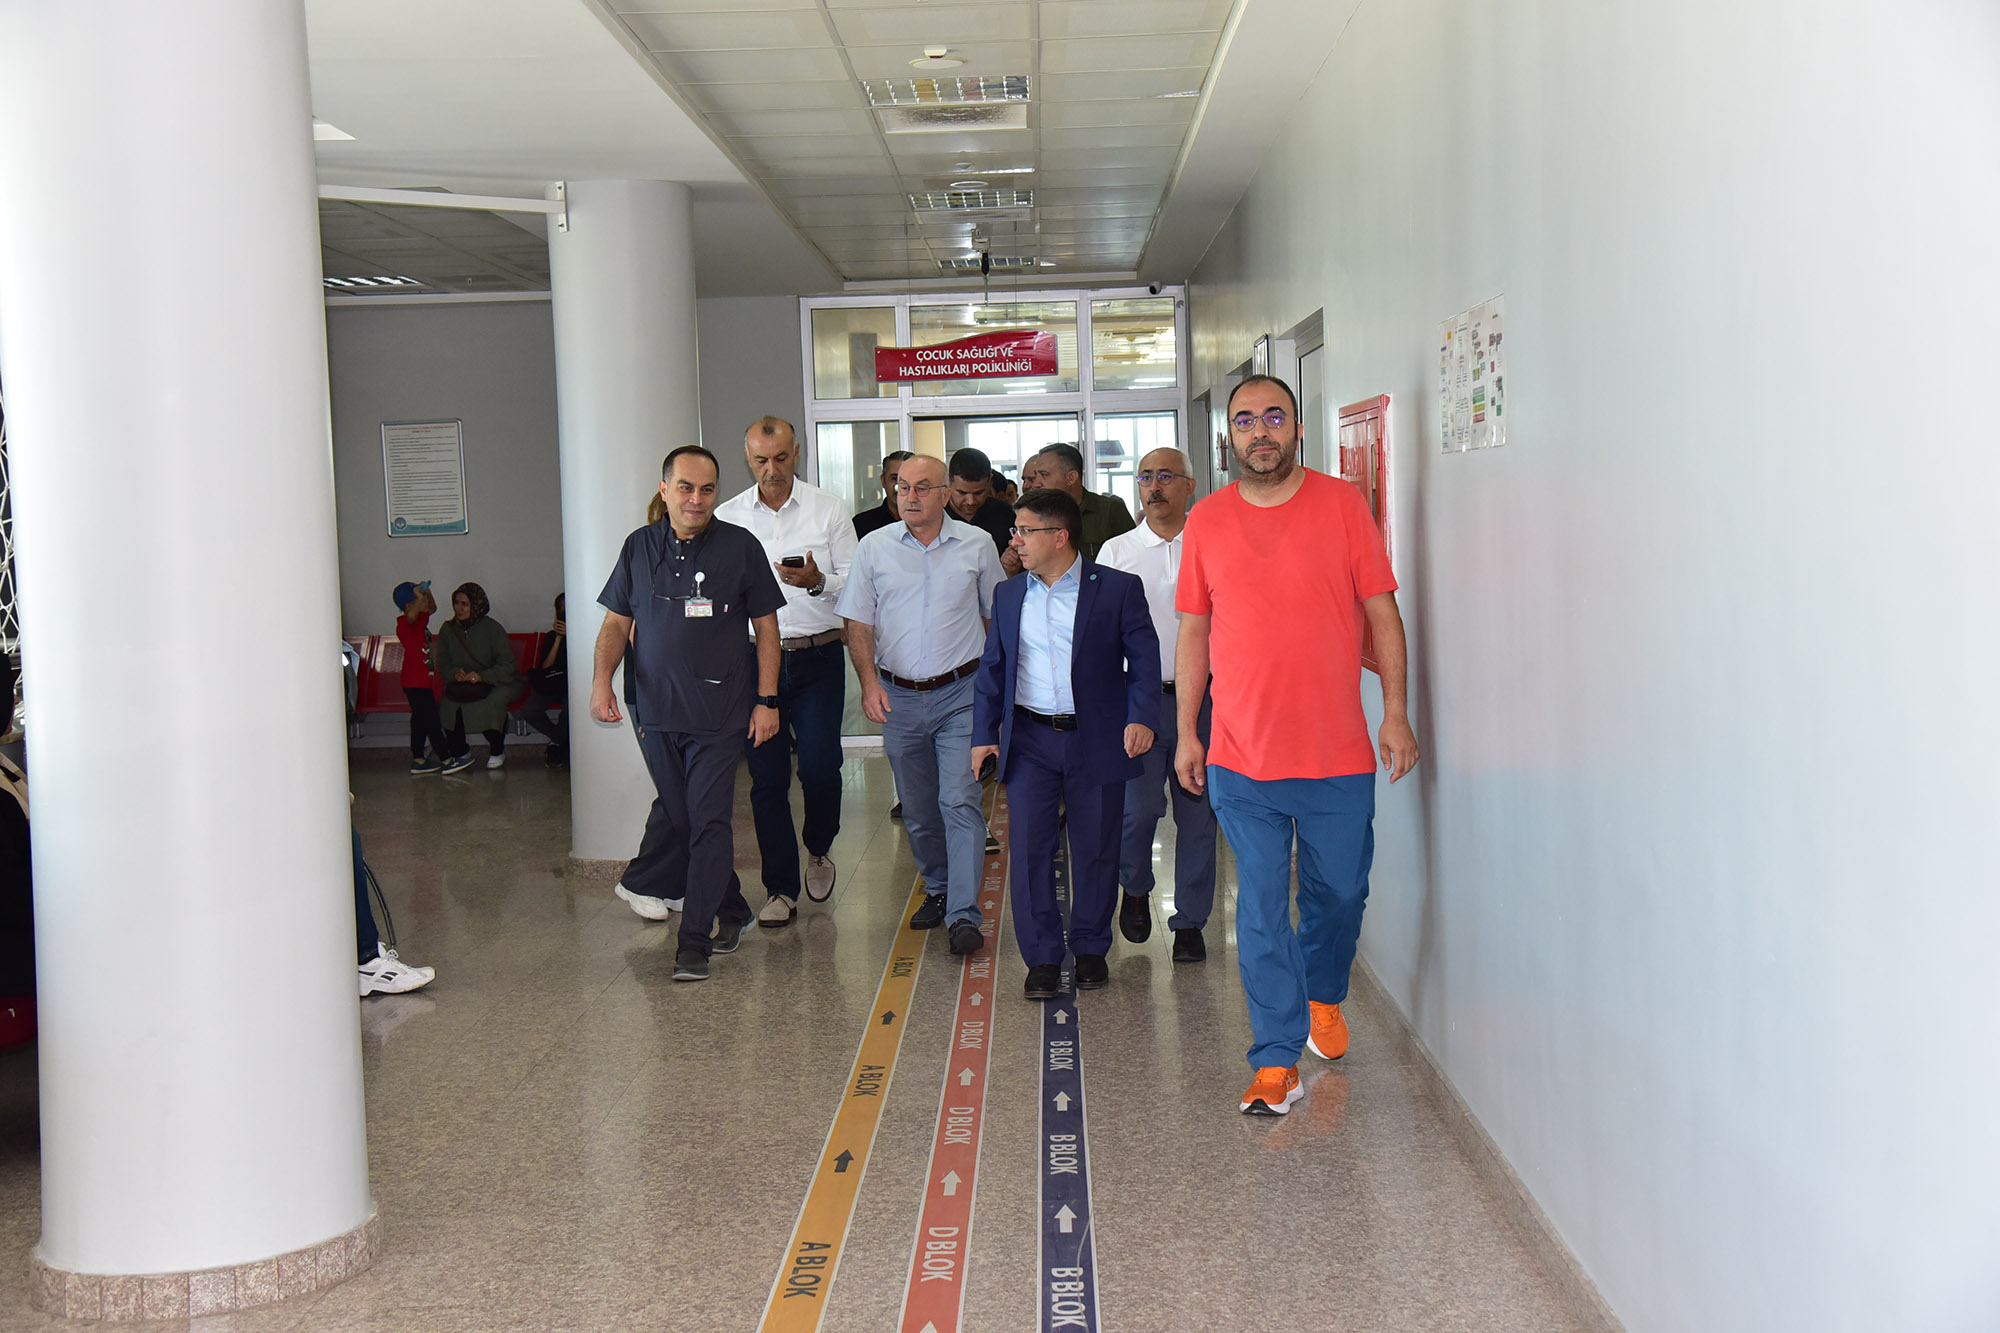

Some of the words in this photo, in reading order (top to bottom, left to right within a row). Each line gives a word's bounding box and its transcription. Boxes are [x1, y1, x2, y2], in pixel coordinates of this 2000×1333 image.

[916, 350, 954, 363] ÇOCUK
[957, 346, 998, 359] SAĞLIĞI
[1001, 347, 1014, 357] VE
[899, 364, 970, 376] HASTALIKLARI
[973, 359, 1032, 374] POLİKLİNİĞİ
[959, 1028, 984, 1050] BLOK
[1049, 1047, 1074, 1071] BLOK
[852, 1072, 884, 1097] BLOK
[948, 1106, 974, 1115] D
[944, 1116, 973, 1145] BLOK
[1049, 1134, 1077, 1142] B
[1049, 1144, 1078, 1175] BLOK
[928, 1226, 959, 1238] D
[801, 1241, 832, 1253] A
[920, 1240, 957, 1282] BLOK
[783, 1254, 828, 1298] BLOK
[1050, 1267, 1084, 1279] B
[1050, 1281, 1086, 1328] BLOK
